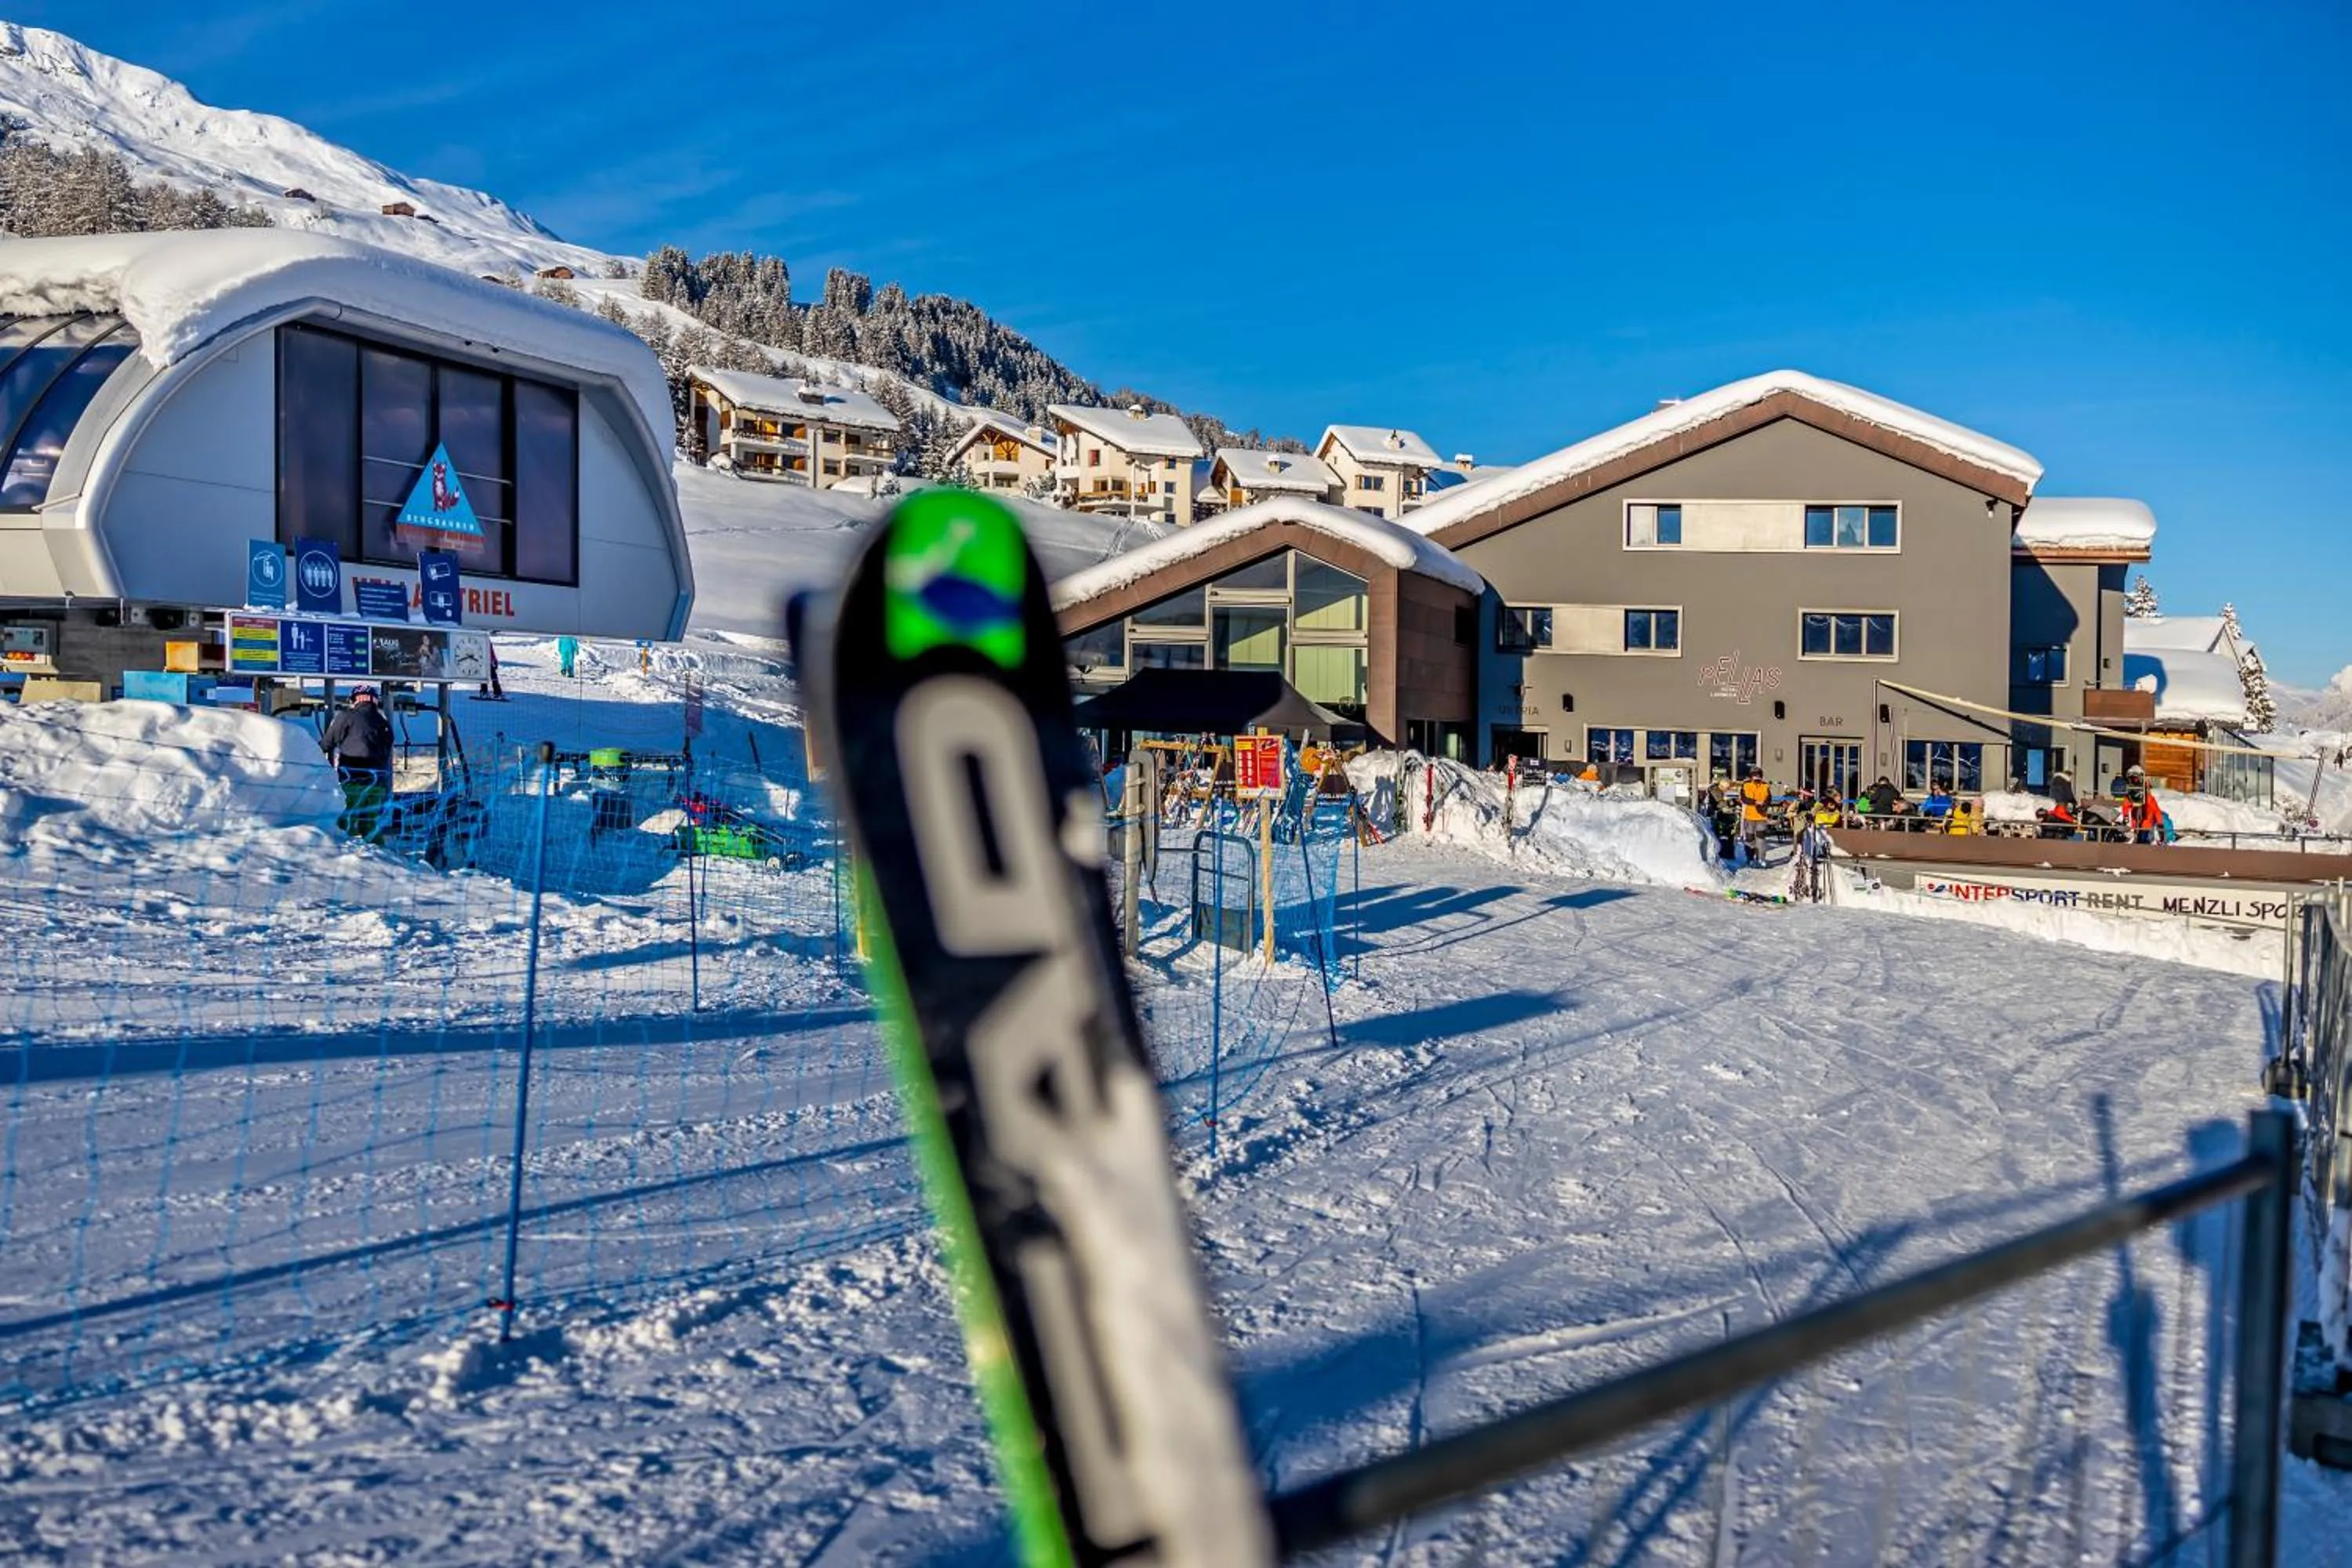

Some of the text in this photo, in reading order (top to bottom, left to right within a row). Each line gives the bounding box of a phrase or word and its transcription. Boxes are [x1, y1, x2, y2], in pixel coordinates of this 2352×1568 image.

[1819, 716, 1844, 728] BAR
[2086, 891, 2144, 912] RENT
[2163, 896, 2241, 916] MENZLI
